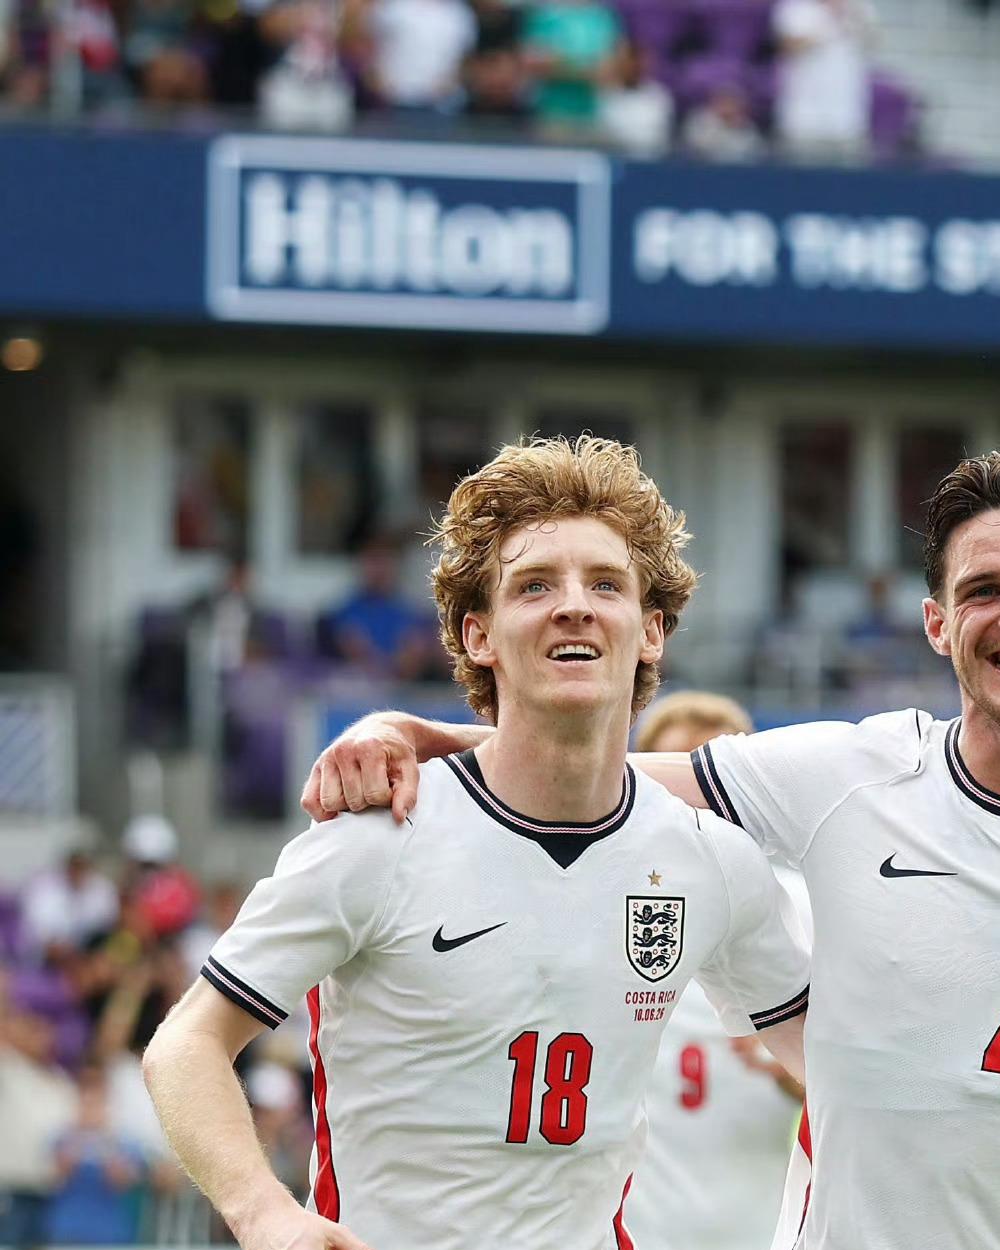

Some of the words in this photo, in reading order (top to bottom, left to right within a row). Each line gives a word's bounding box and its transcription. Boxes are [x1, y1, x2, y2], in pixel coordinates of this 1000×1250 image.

[243, 170, 574, 297] Hilton
[632, 205, 779, 288] FOR
[786, 212, 927, 294] THE
[625, 991, 657, 1005] COSTA
[658, 990, 676, 1003] RICA
[633, 1006, 666, 1022] 10.06.26
[505, 1030, 593, 1146] 18
[680, 1043, 706, 1111] 9
